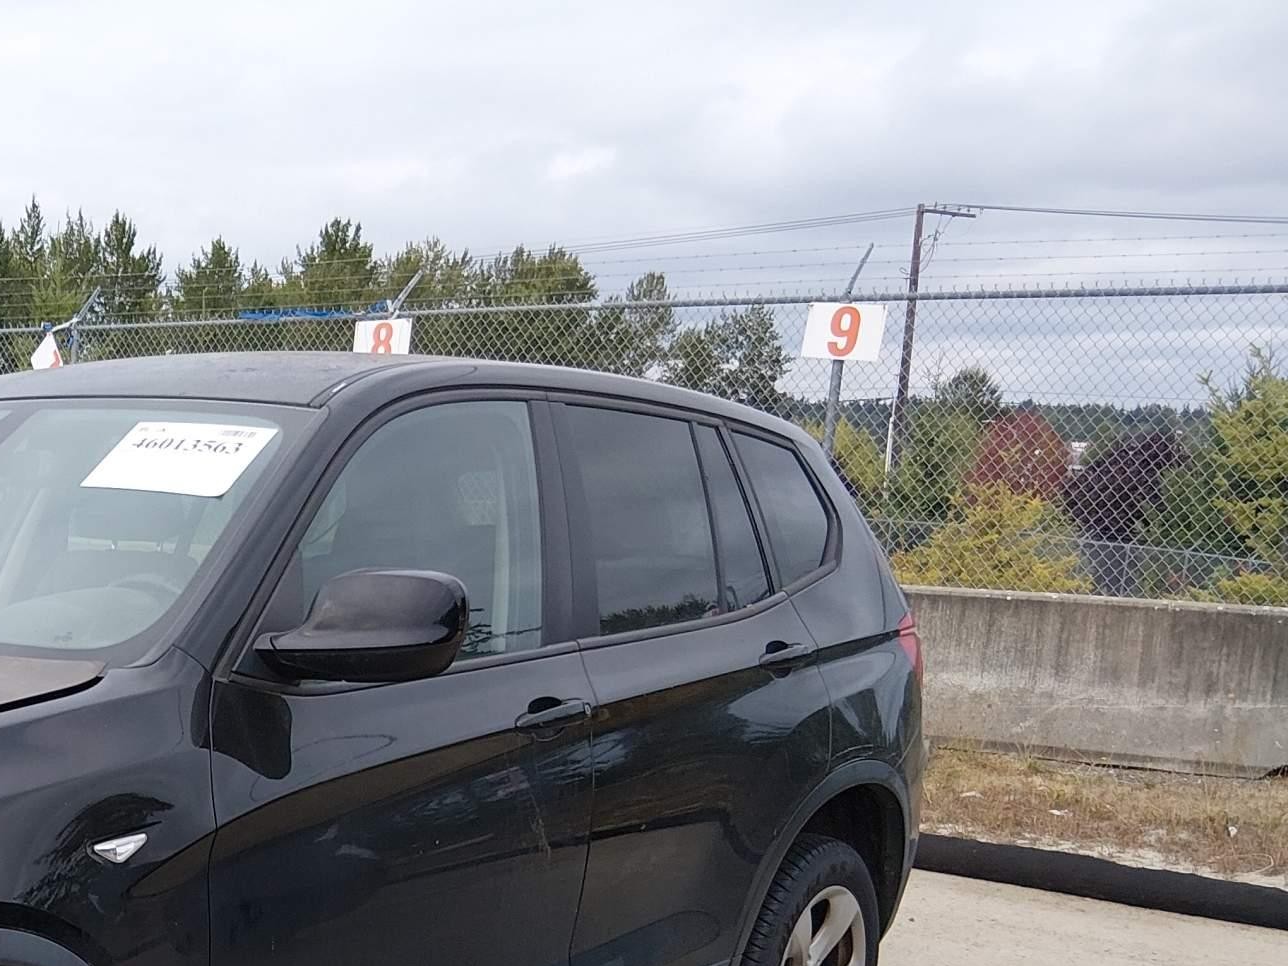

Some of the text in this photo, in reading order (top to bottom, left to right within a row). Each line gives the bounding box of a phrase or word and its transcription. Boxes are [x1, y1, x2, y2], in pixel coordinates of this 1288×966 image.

[371, 322, 393, 354] 8
[827, 305, 862, 358] 9
[132, 438, 244, 455] 46013563
